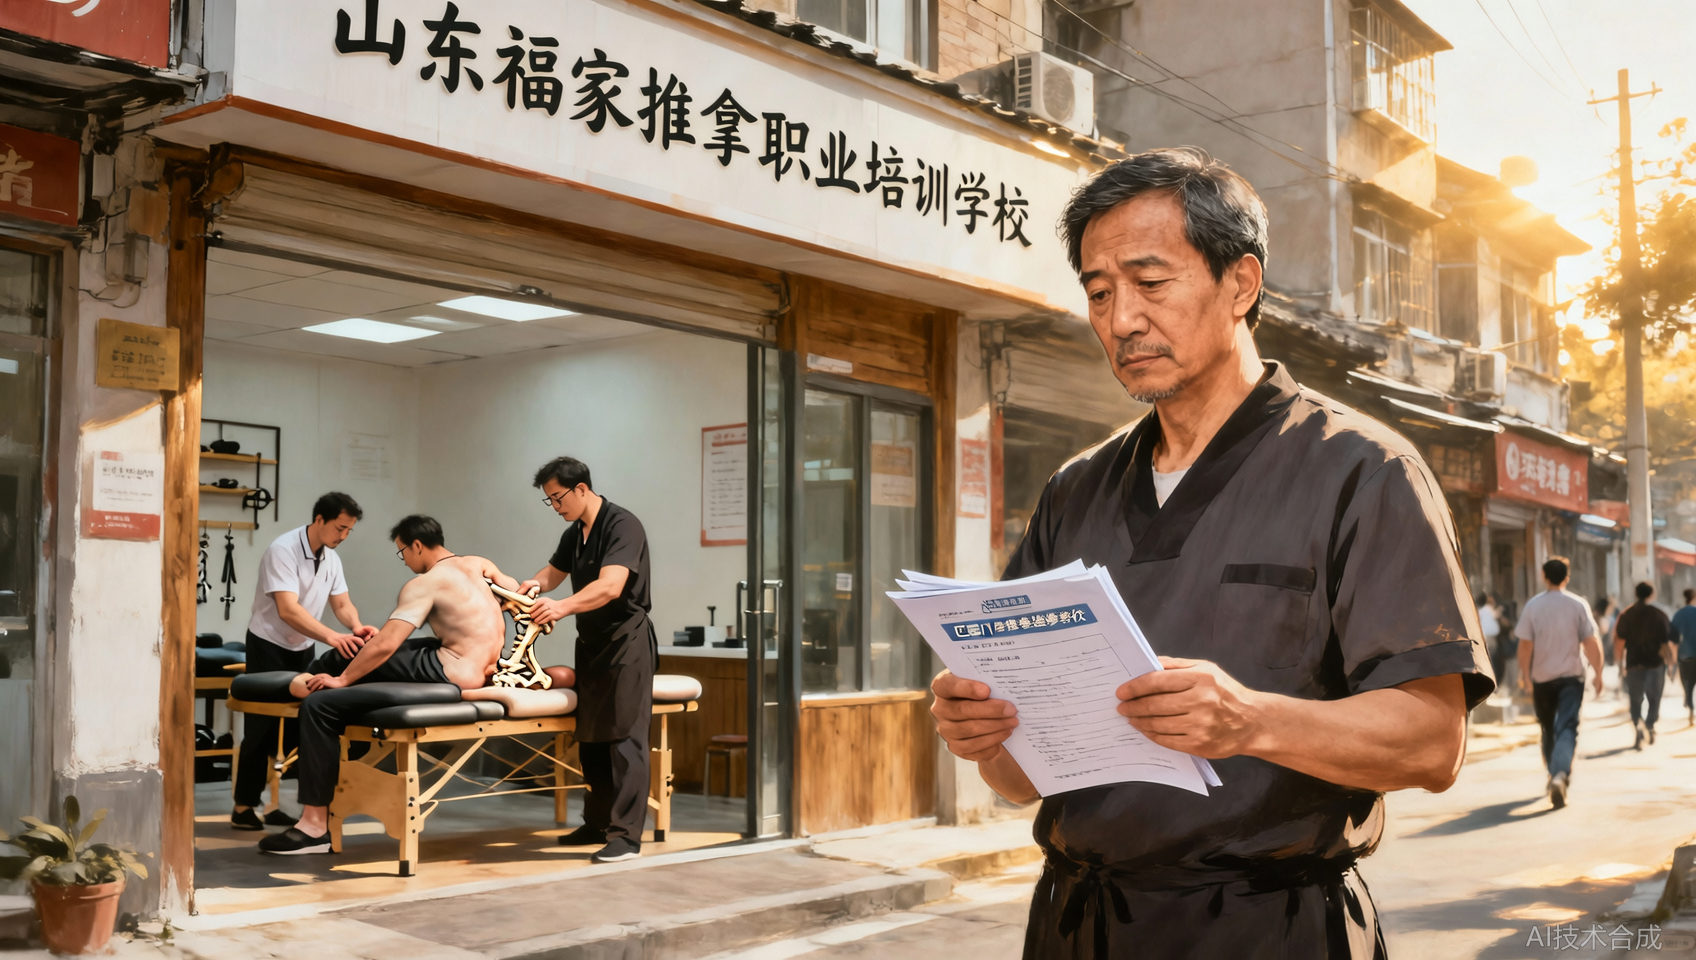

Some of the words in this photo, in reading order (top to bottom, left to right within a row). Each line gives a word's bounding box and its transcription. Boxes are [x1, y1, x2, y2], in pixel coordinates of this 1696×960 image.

[334, 0, 1032, 248] 山东福家推拿职业培训学校
